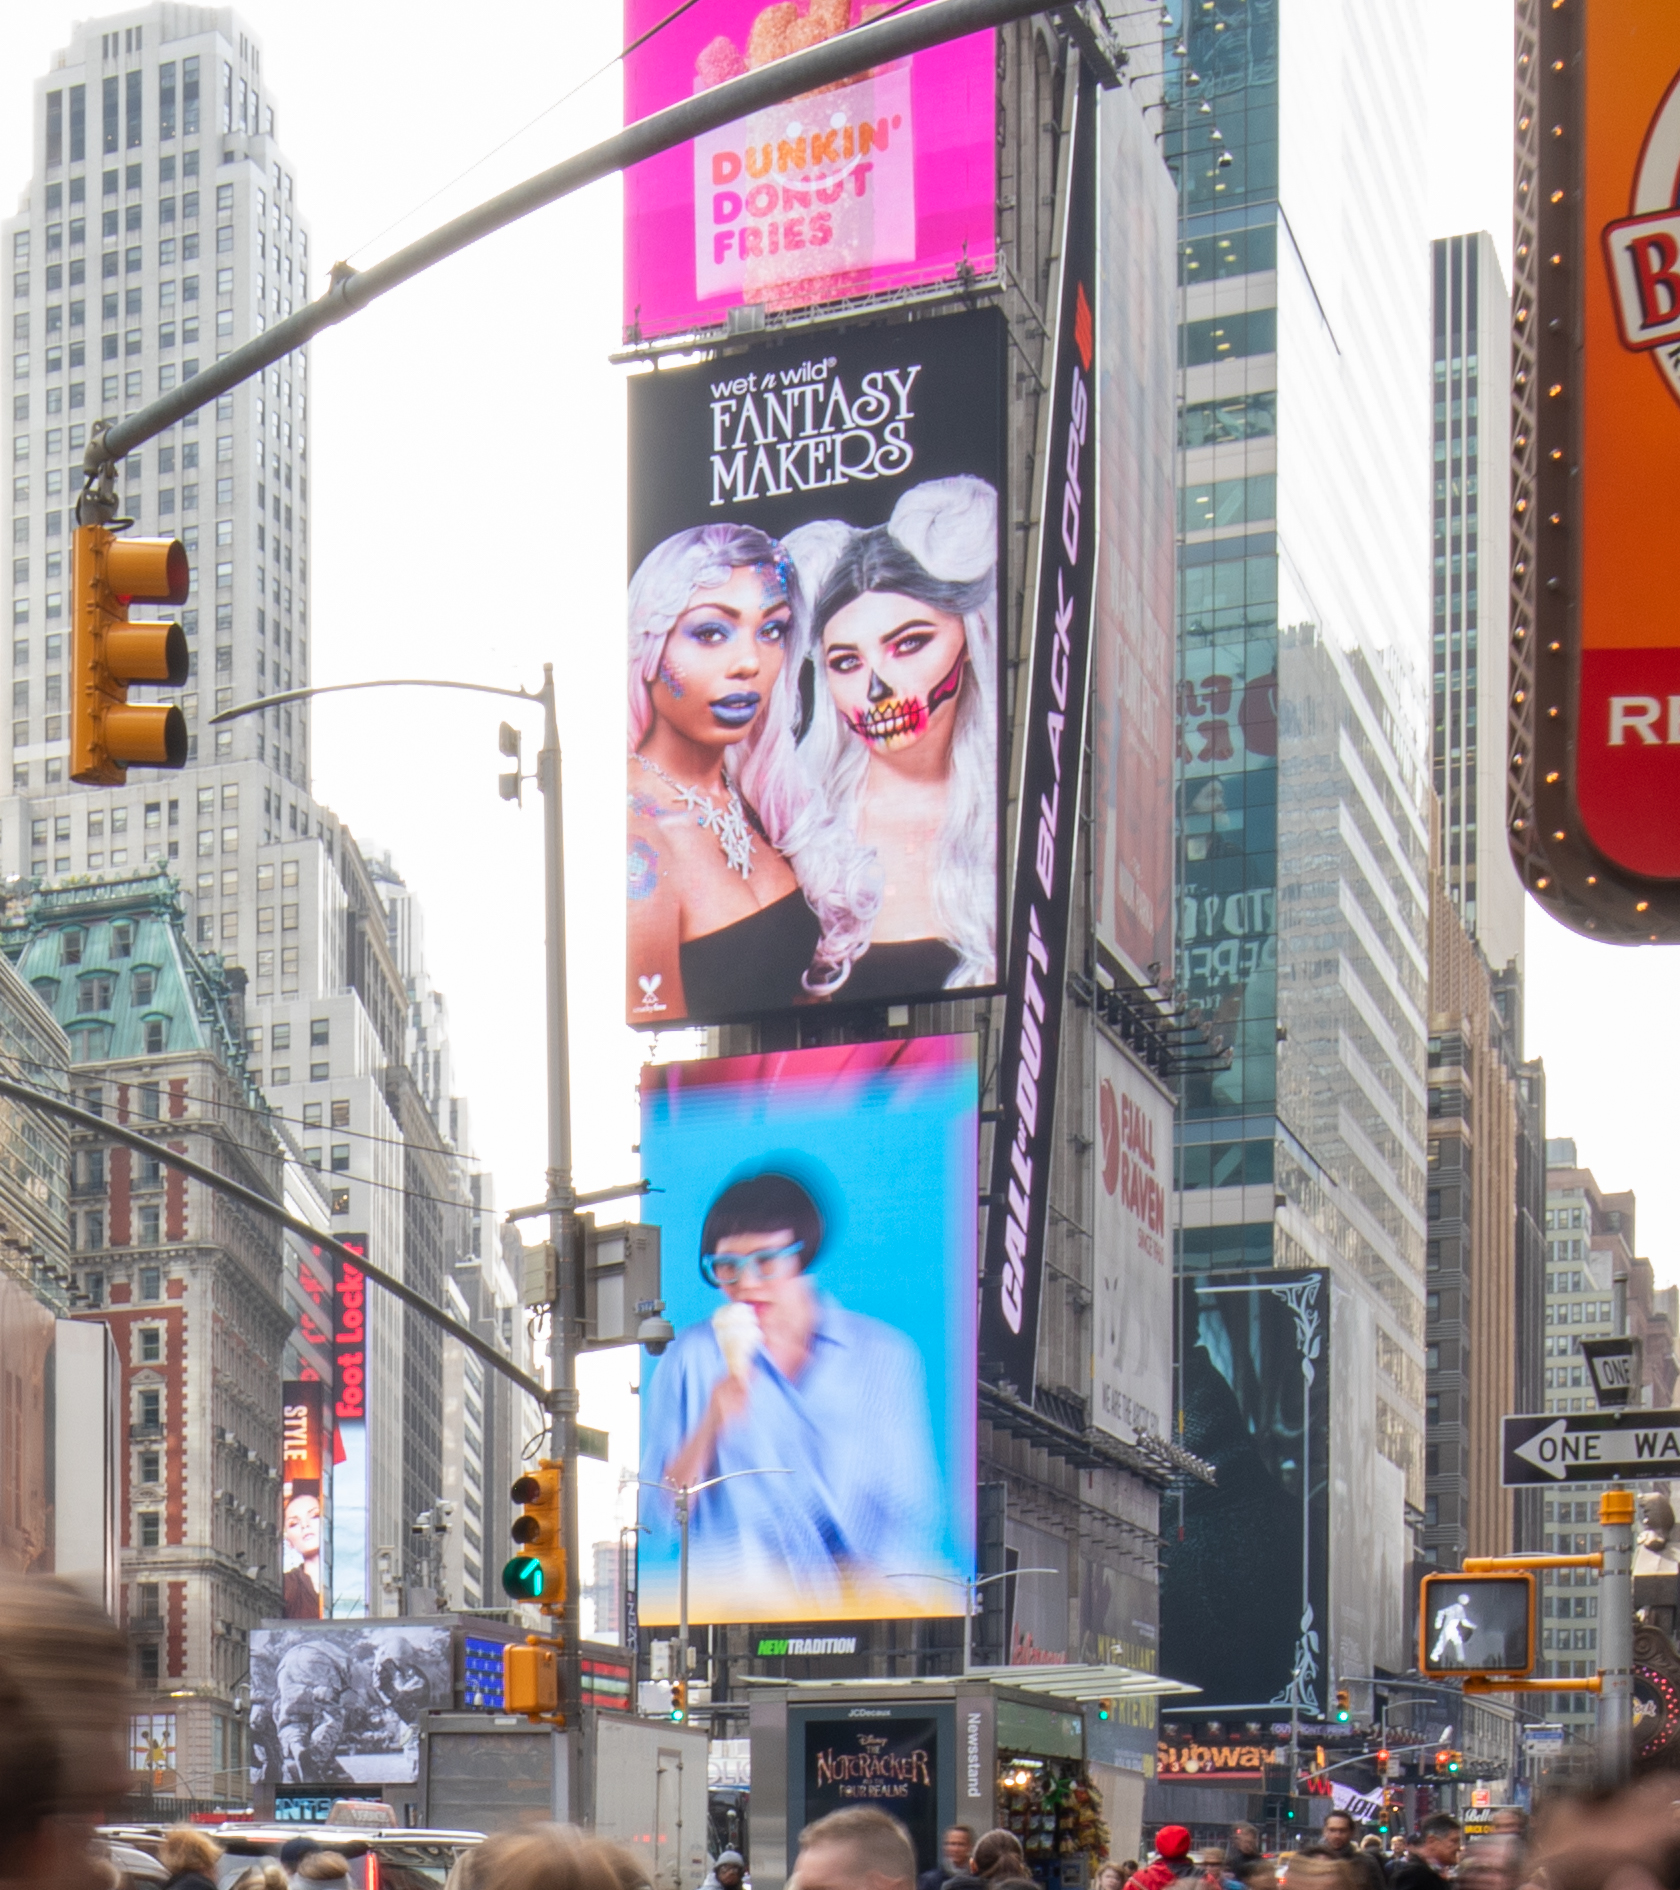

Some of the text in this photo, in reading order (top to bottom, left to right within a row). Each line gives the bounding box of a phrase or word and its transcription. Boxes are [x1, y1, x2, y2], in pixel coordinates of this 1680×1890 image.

[712, 113, 903, 186] DUNKIN'
[712, 161, 873, 226] DONUT
[712, 210, 833, 266] FRIES
[709, 364, 922, 452] FANTASY
[710, 372, 758, 400] wet
[760, 372, 777, 391] n
[709, 421, 914, 506] MAKERS
[1035, 565, 1075, 901] BLACK
[1016, 903, 1050, 1137] DUTY
[1001, 1138, 1033, 1335] CALL
[334, 1351, 364, 1418] Foot
[1602, 1358, 1631, 1386] ONE
[284, 1405, 308, 1463] STYLE
[1539, 1435, 1601, 1463] ONE
[816, 1747, 931, 1789] NUTCRACKER
[967, 1712, 982, 1798] Newsstand
